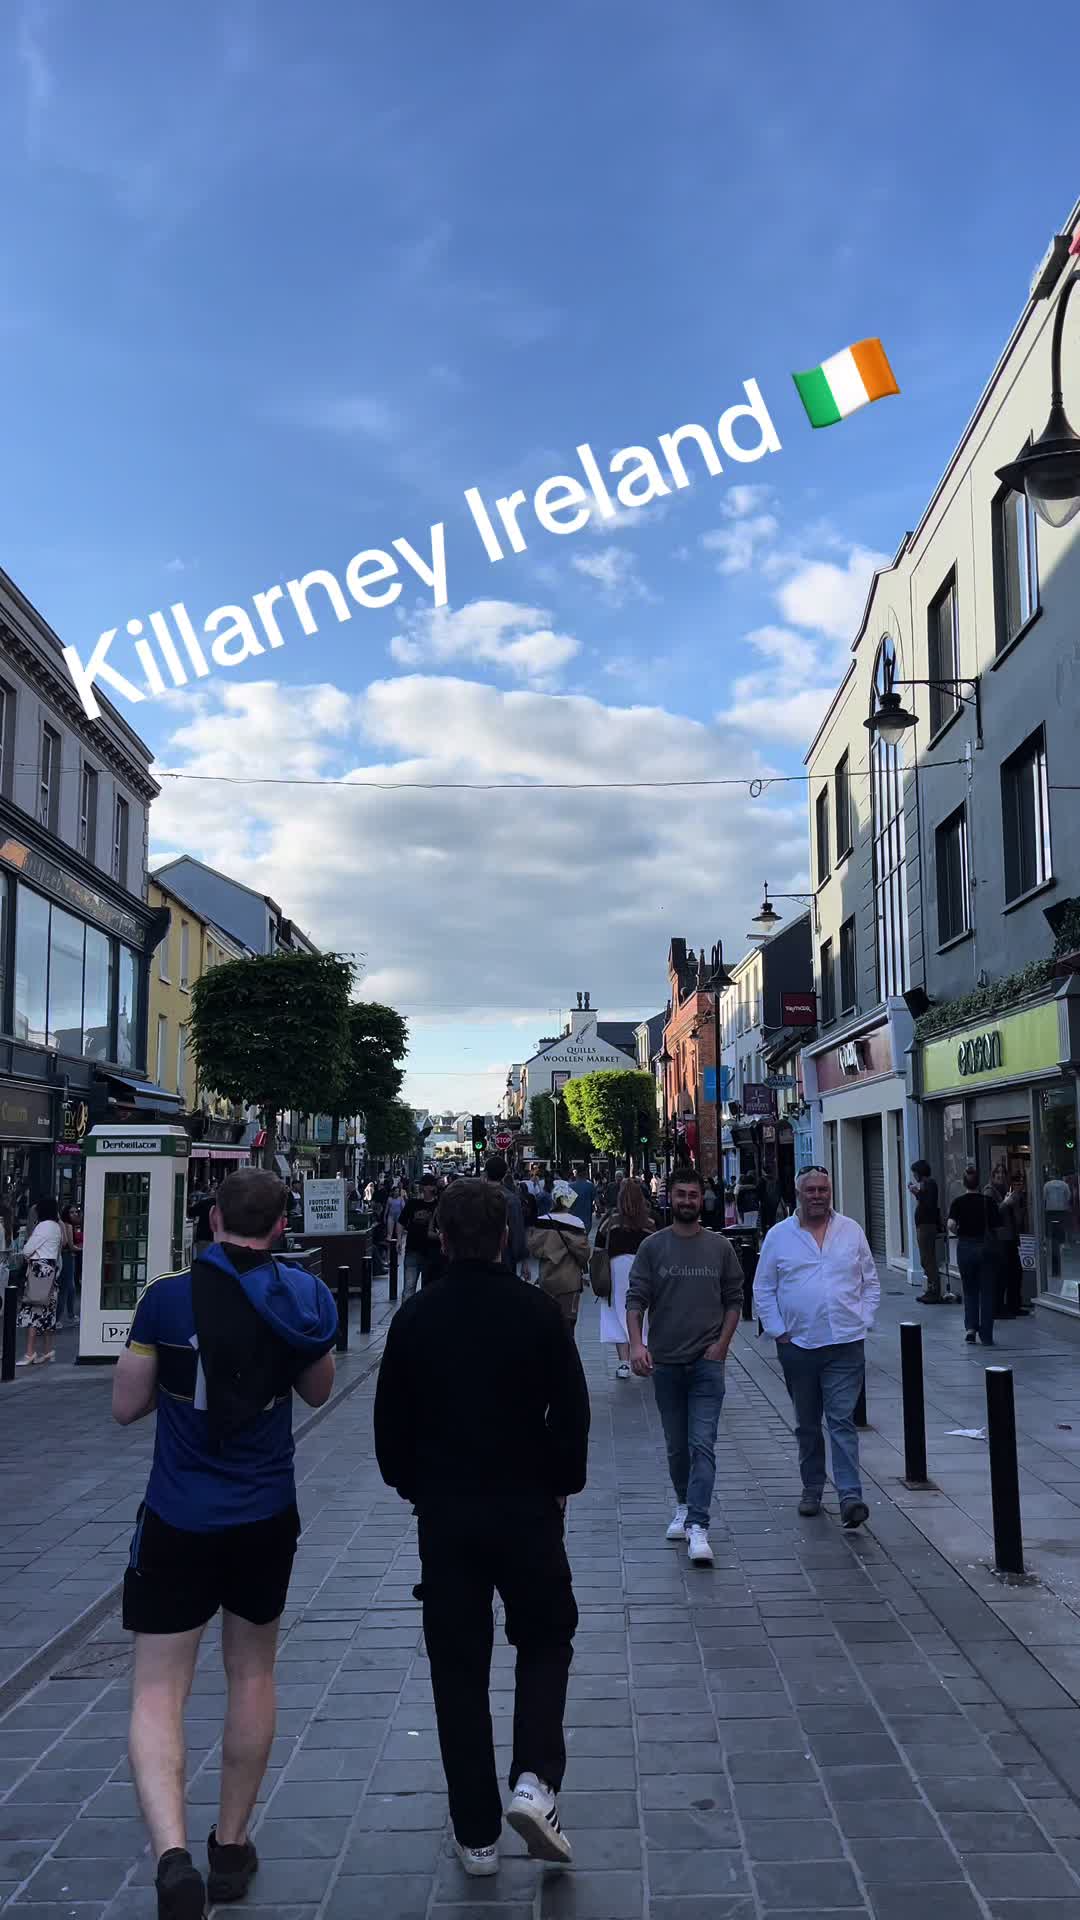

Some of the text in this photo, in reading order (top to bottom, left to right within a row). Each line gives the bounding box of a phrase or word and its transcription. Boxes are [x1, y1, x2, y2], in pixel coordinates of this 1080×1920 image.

[566, 1046, 597, 1055] QUILLS
[542, 1055, 620, 1063] WOOLLEN MARKET
[668, 1264, 719, 1276] Columbia
